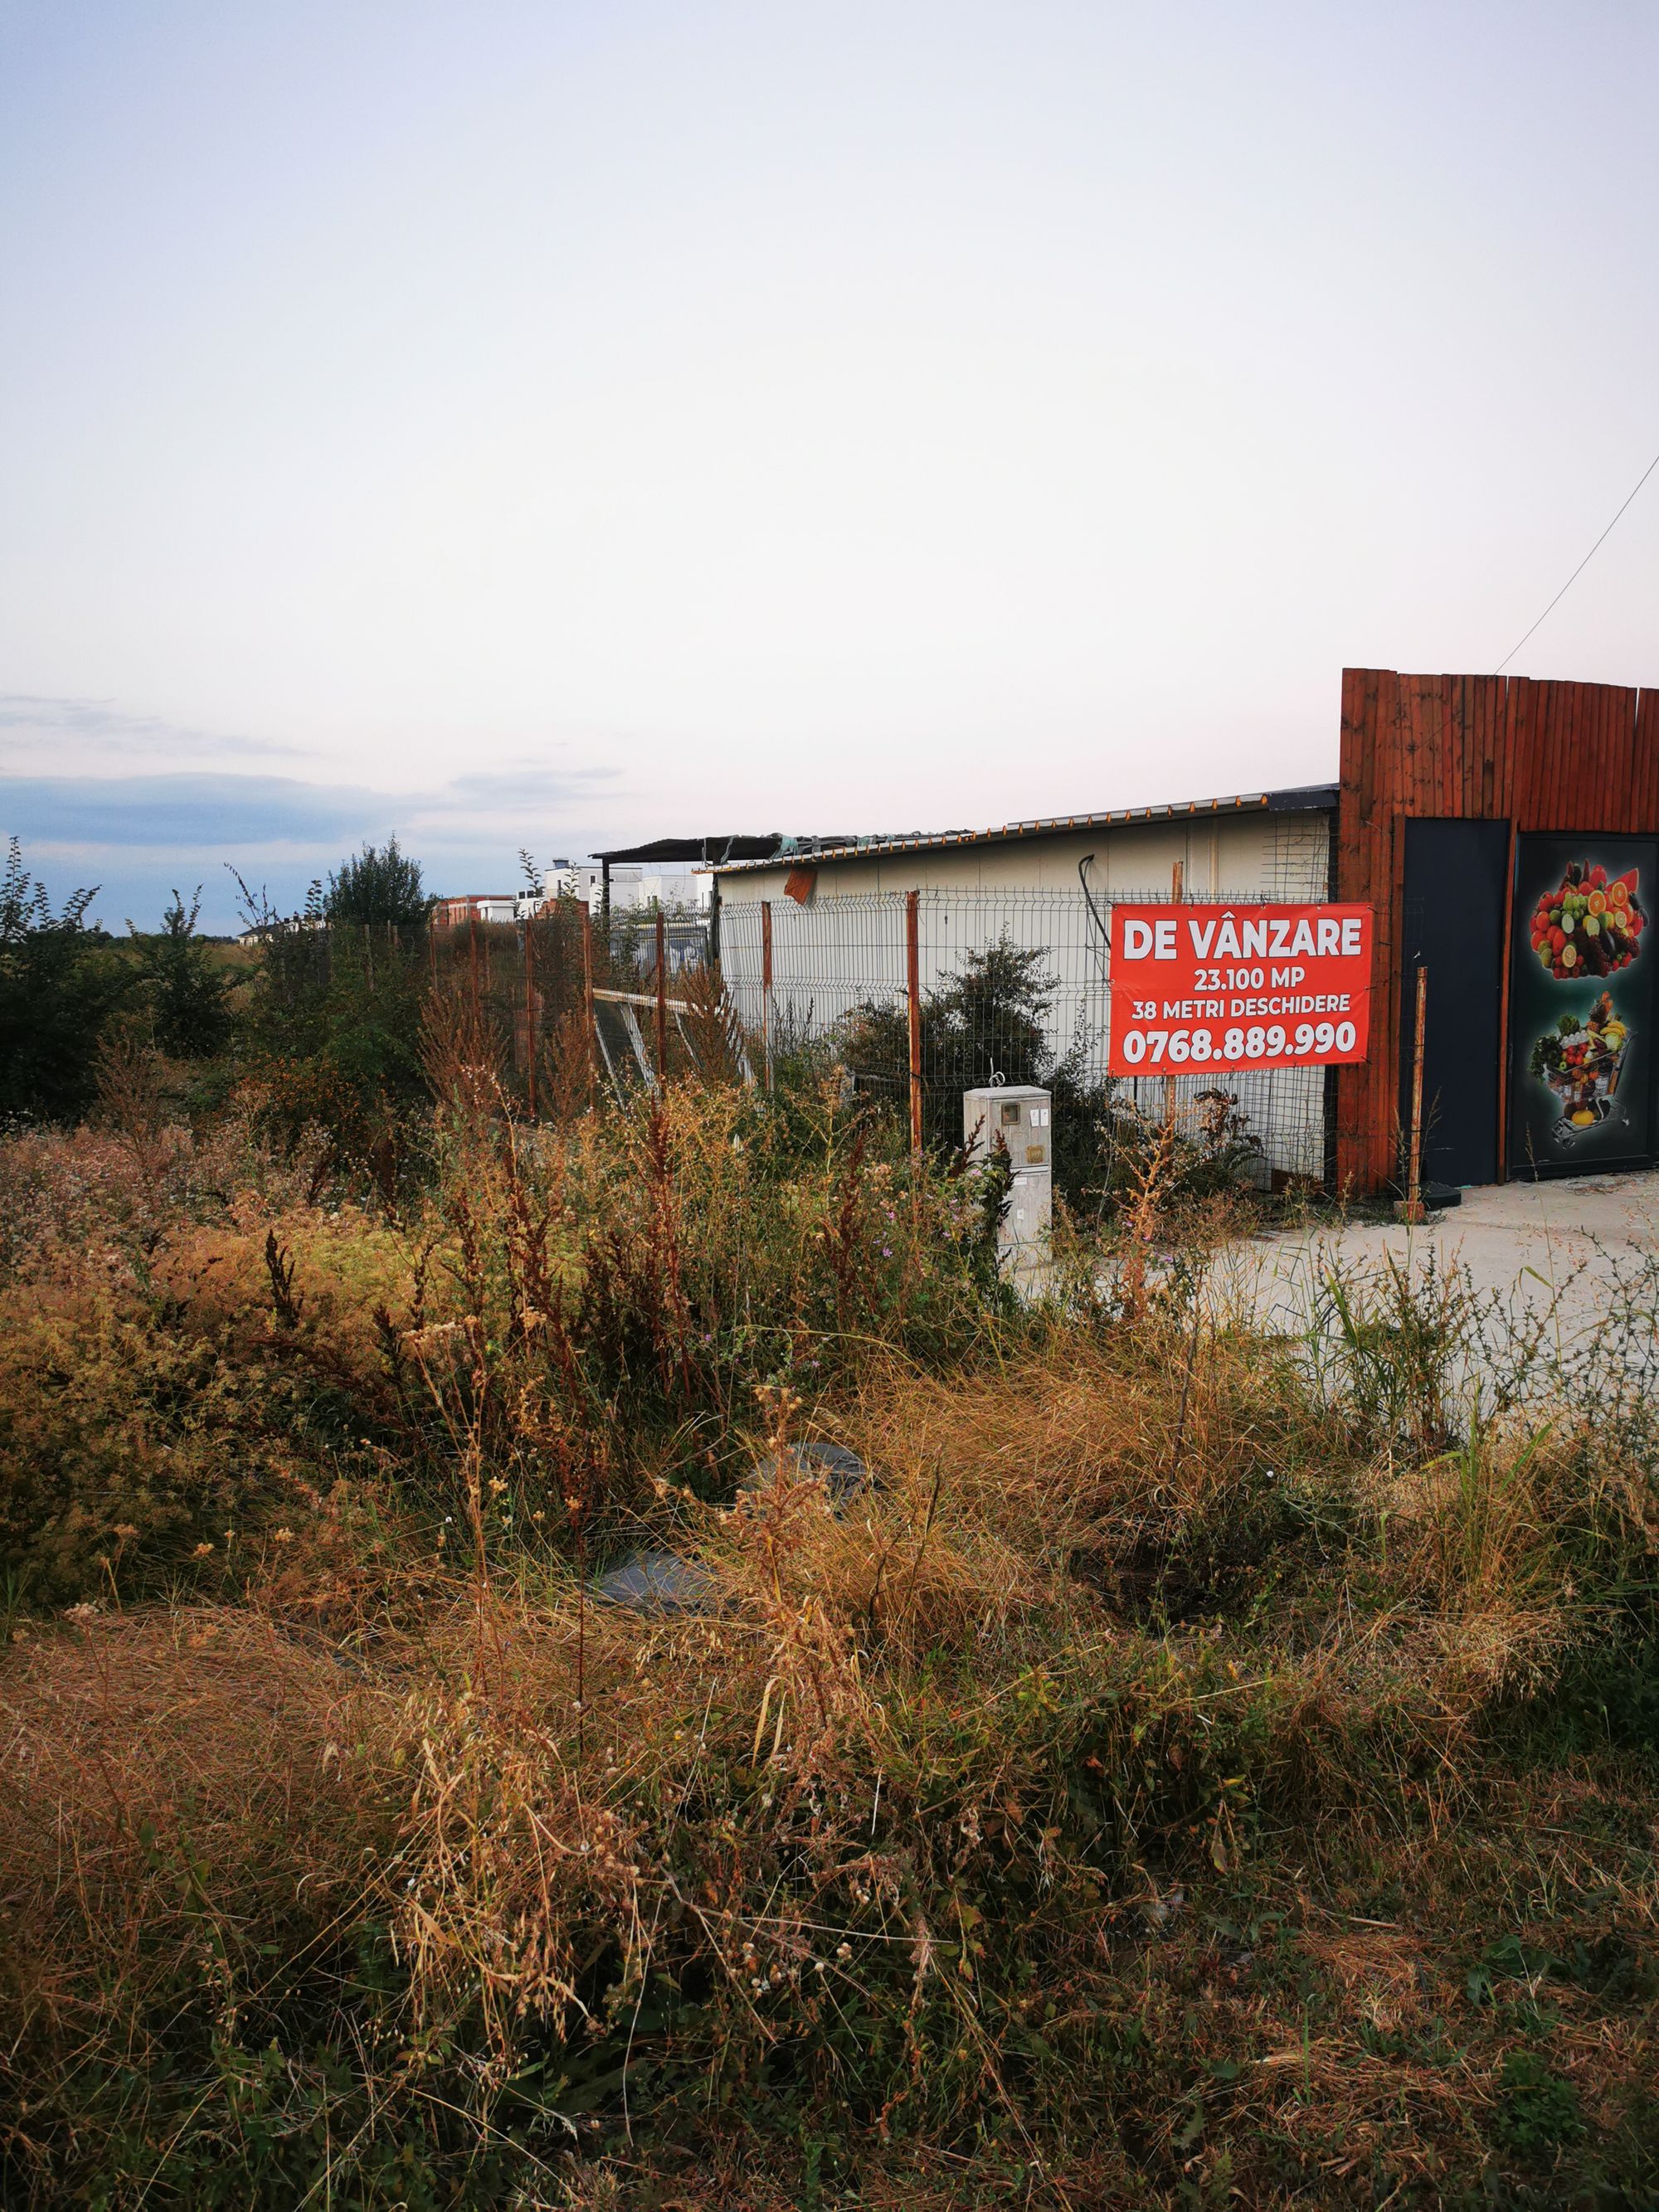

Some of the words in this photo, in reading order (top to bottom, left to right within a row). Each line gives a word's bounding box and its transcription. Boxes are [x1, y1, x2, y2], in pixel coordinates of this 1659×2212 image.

[1124, 920, 1177, 960] DE
[1188, 911, 1361, 960] VÂNZARE
[1194, 968, 1264, 991] 23.100
[1272, 967, 1305, 988] MP
[1132, 1001, 1157, 1020] 38
[1163, 999, 1224, 1019] METRI
[1231, 994, 1350, 1017] DESCHIDERE
[1123, 1021, 1357, 1063] 0768.889.990
